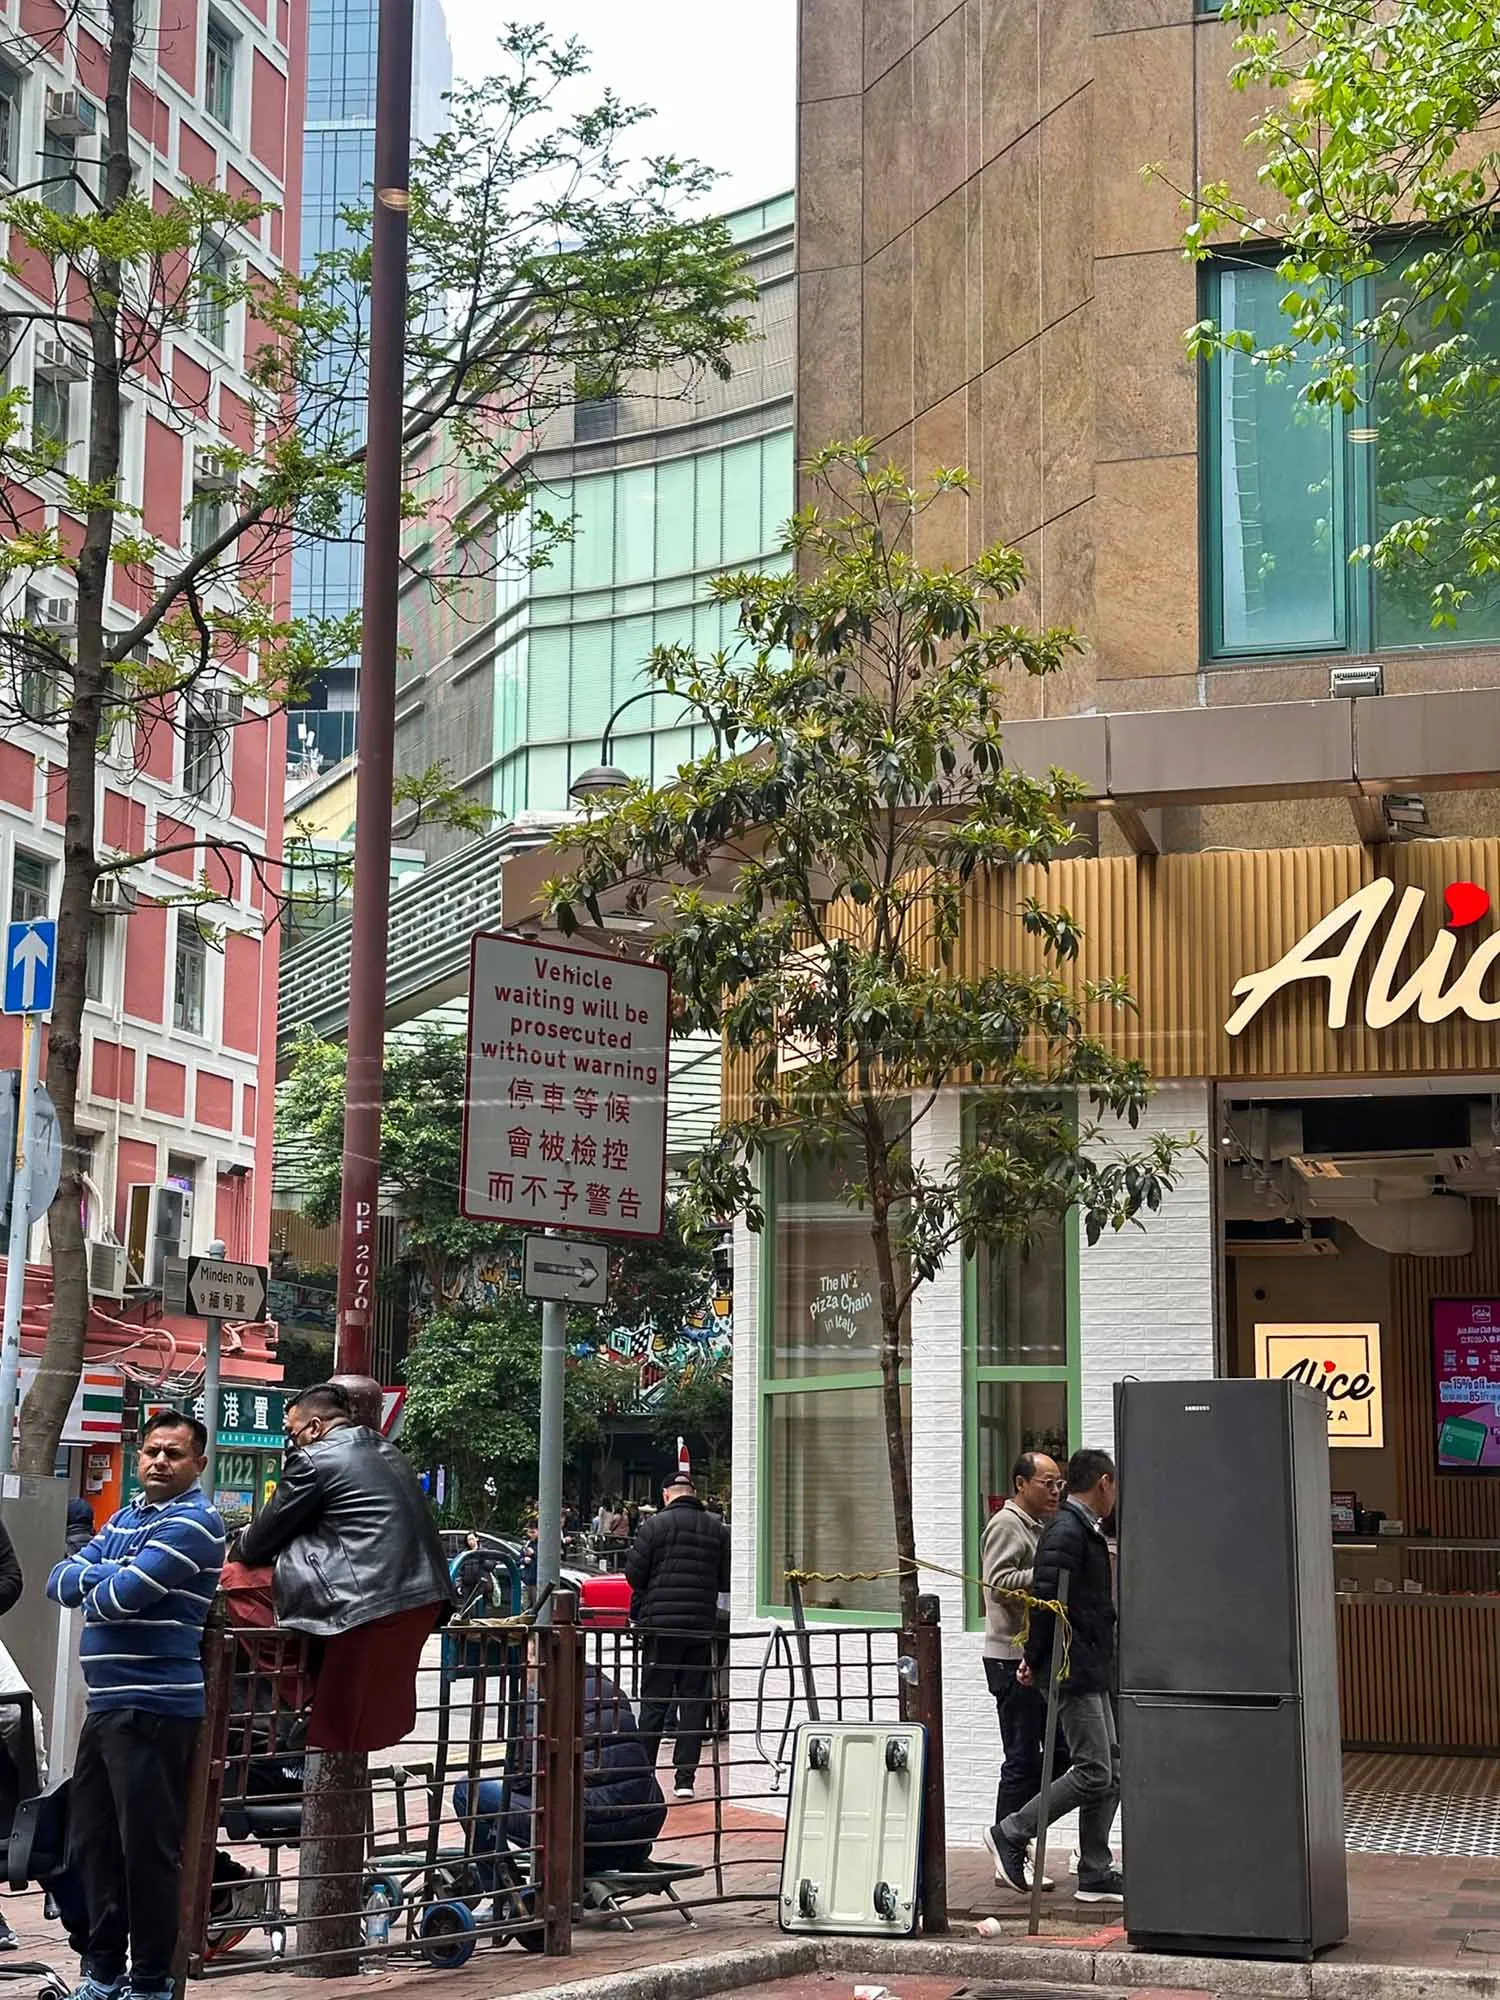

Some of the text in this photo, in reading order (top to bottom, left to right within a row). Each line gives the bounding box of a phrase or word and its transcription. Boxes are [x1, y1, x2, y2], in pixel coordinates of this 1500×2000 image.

[535, 957, 613, 990] Vehicle
[494, 984, 649, 1025] waiting will be
[511, 1014, 632, 1050] prosecuted
[481, 1040, 658, 1085] without warning
[507, 1077, 631, 1124] 停車等候
[507, 1125, 629, 1172] 會被檢控
[487, 1170, 643, 1220] 而不予警告
[200, 1266, 256, 1287] Minden Row
[820, 1275, 839, 1292] The
[841, 1292, 873, 1314] Chain
[835, 1315, 857, 1339] Italy
[192, 1391, 290, 1431] 香港置
[219, 1455, 254, 1485] 1122
